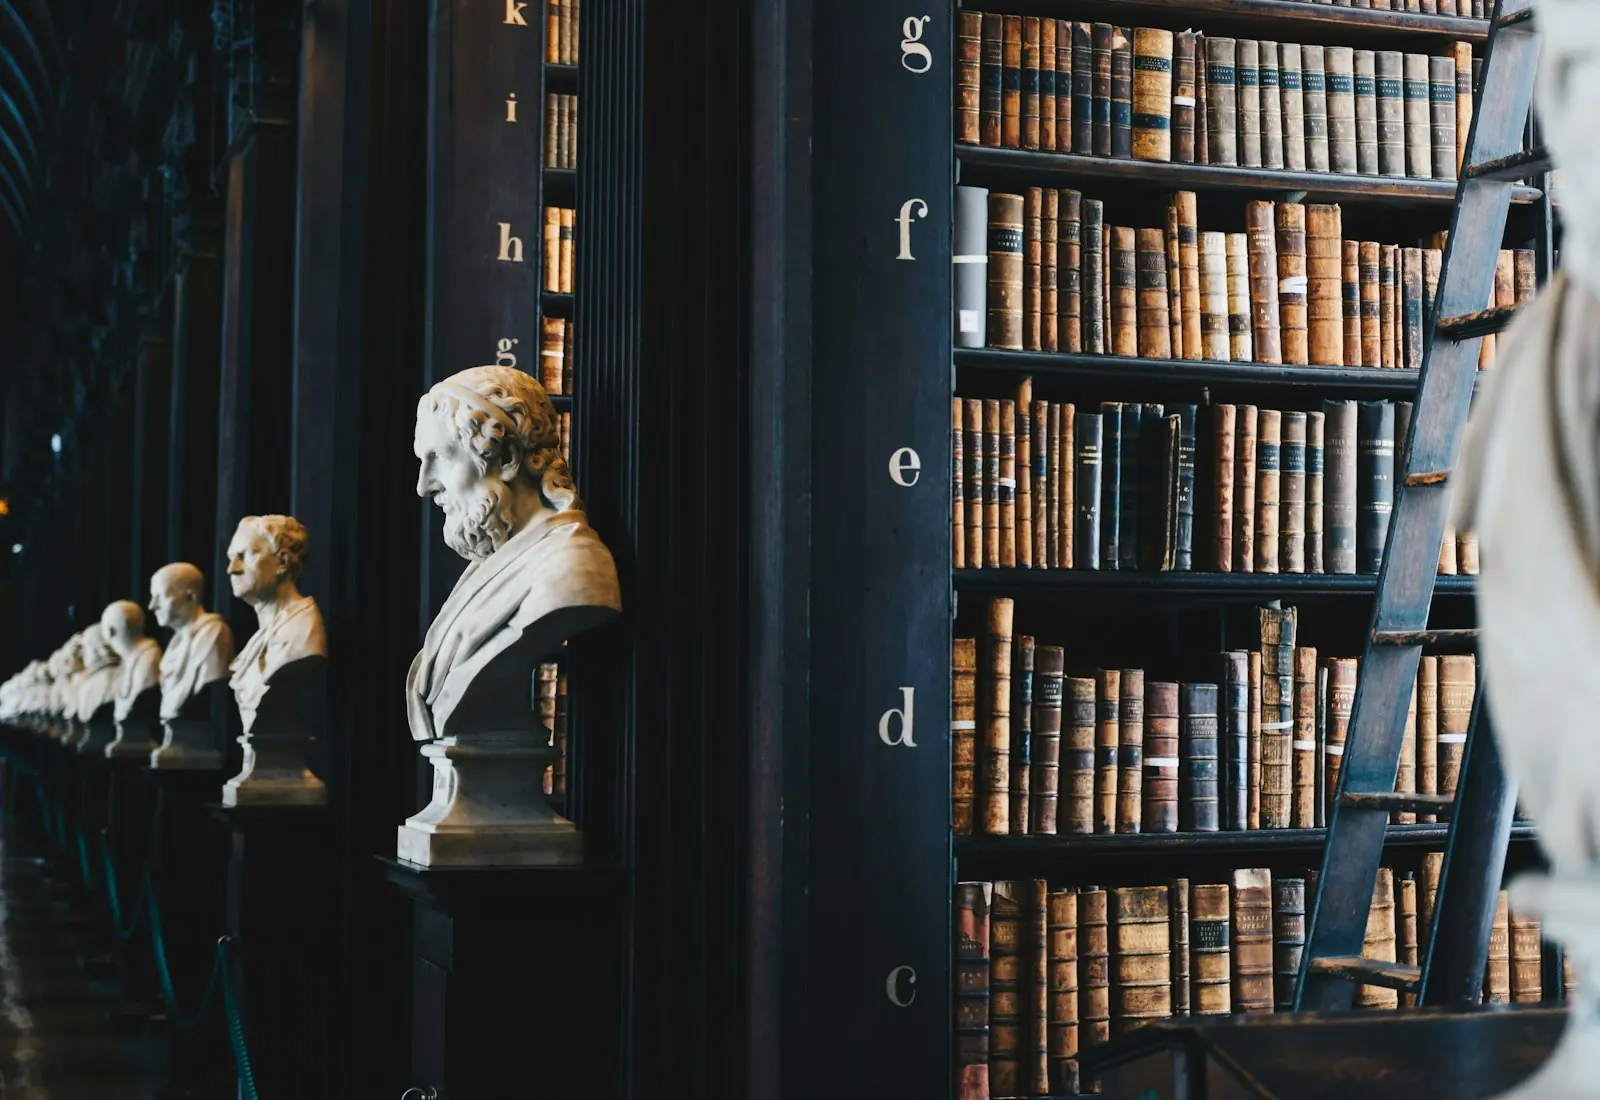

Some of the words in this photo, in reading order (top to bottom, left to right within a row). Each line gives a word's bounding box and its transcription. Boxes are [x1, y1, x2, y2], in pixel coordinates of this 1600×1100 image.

[502, 0, 528, 26] k
[900, 14, 933, 74] g
[505, 92, 518, 123] i
[496, 222, 524, 262] h
[894, 198, 929, 261] f
[496, 337, 519, 368] g
[888, 446, 922, 488] e
[878, 686, 918, 748] d
[886, 965, 917, 1007] c
